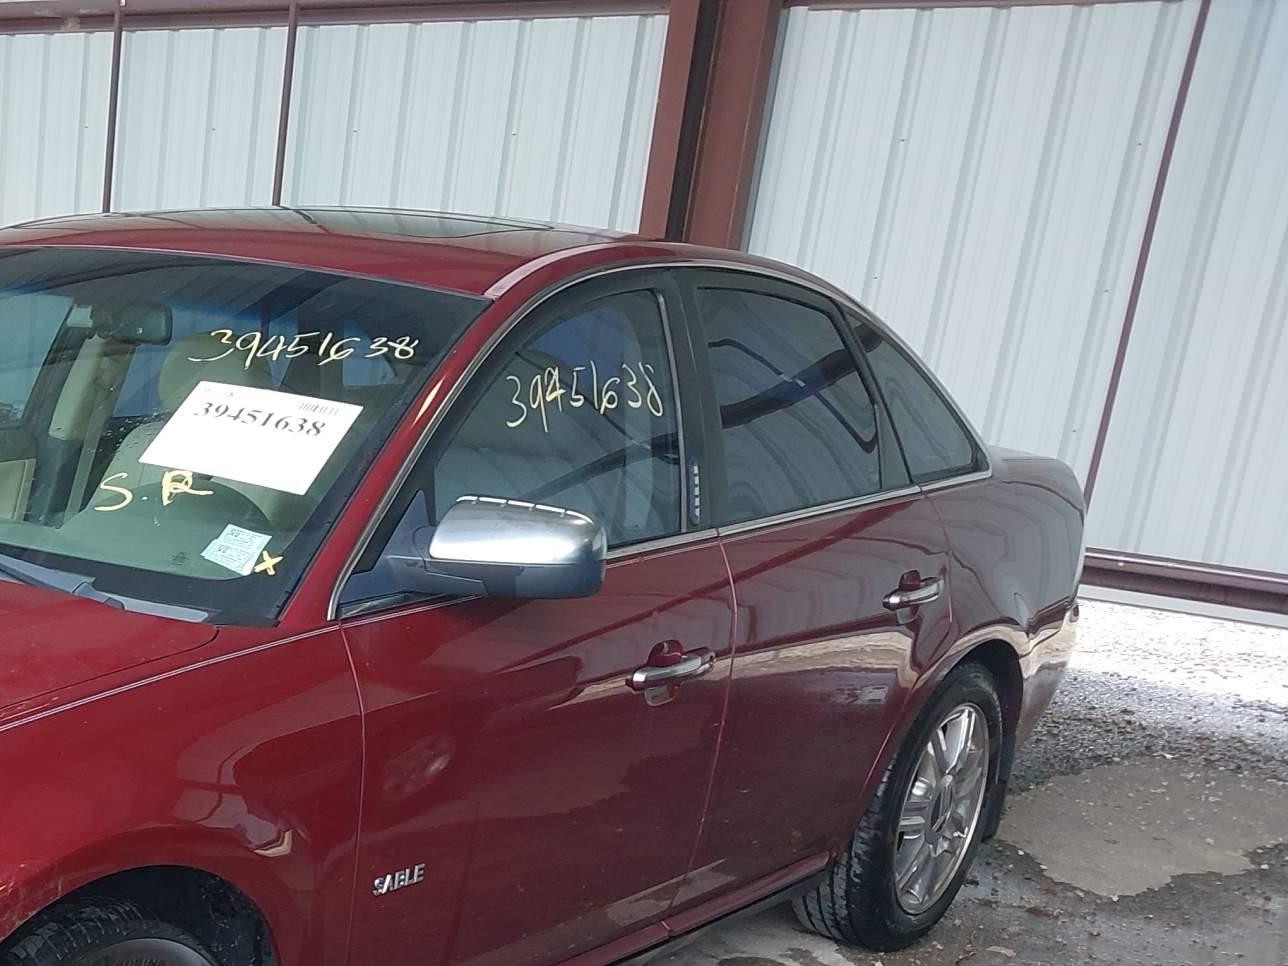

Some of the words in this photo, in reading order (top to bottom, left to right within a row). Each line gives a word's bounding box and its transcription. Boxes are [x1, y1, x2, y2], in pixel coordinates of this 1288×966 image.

[187, 329, 419, 370] 39451638
[505, 360, 664, 432] 39451638
[194, 401, 326, 437] 39451638
[371, 863, 426, 896] SABLE
